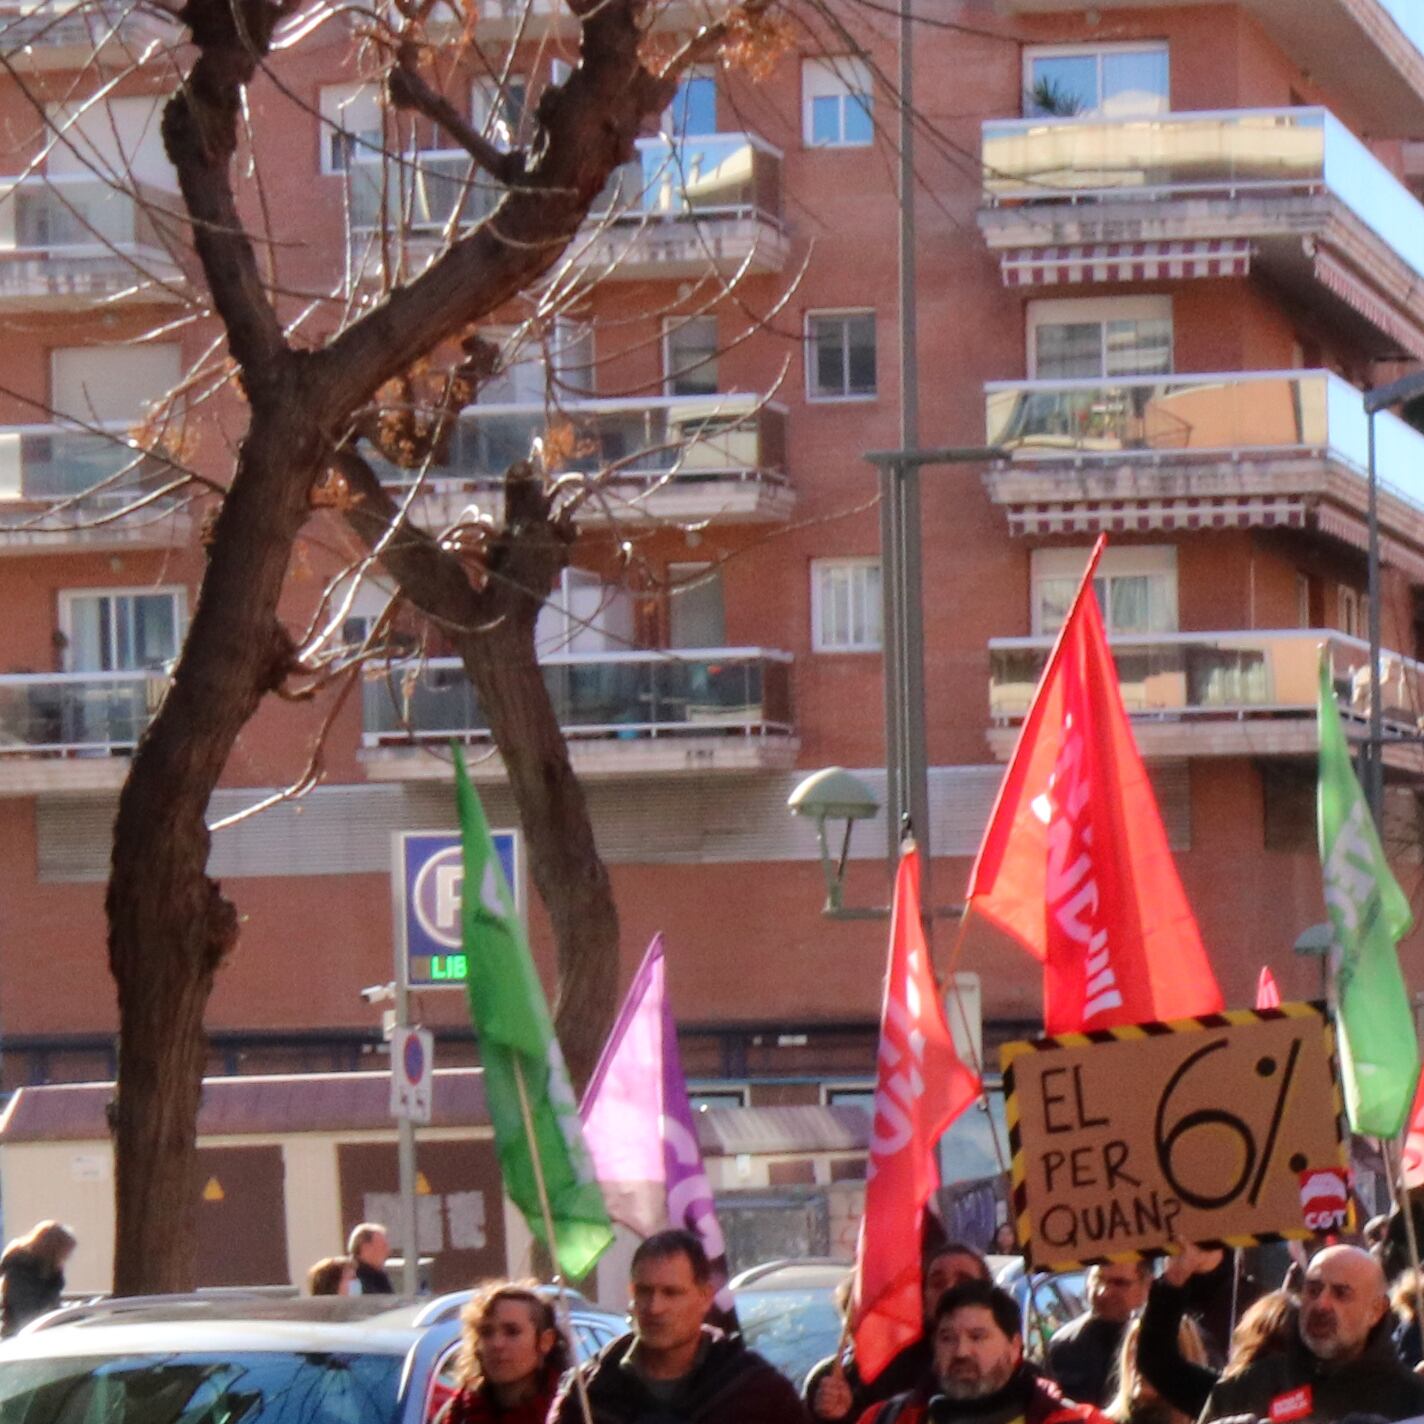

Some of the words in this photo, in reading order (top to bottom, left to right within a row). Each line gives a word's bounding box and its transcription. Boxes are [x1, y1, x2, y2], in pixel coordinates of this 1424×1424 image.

[430, 955, 468, 980] LIB
[1040, 1064, 1109, 1135] EL
[1041, 1140, 1142, 1193] PER
[1040, 1190, 1182, 1248] QUAN?
